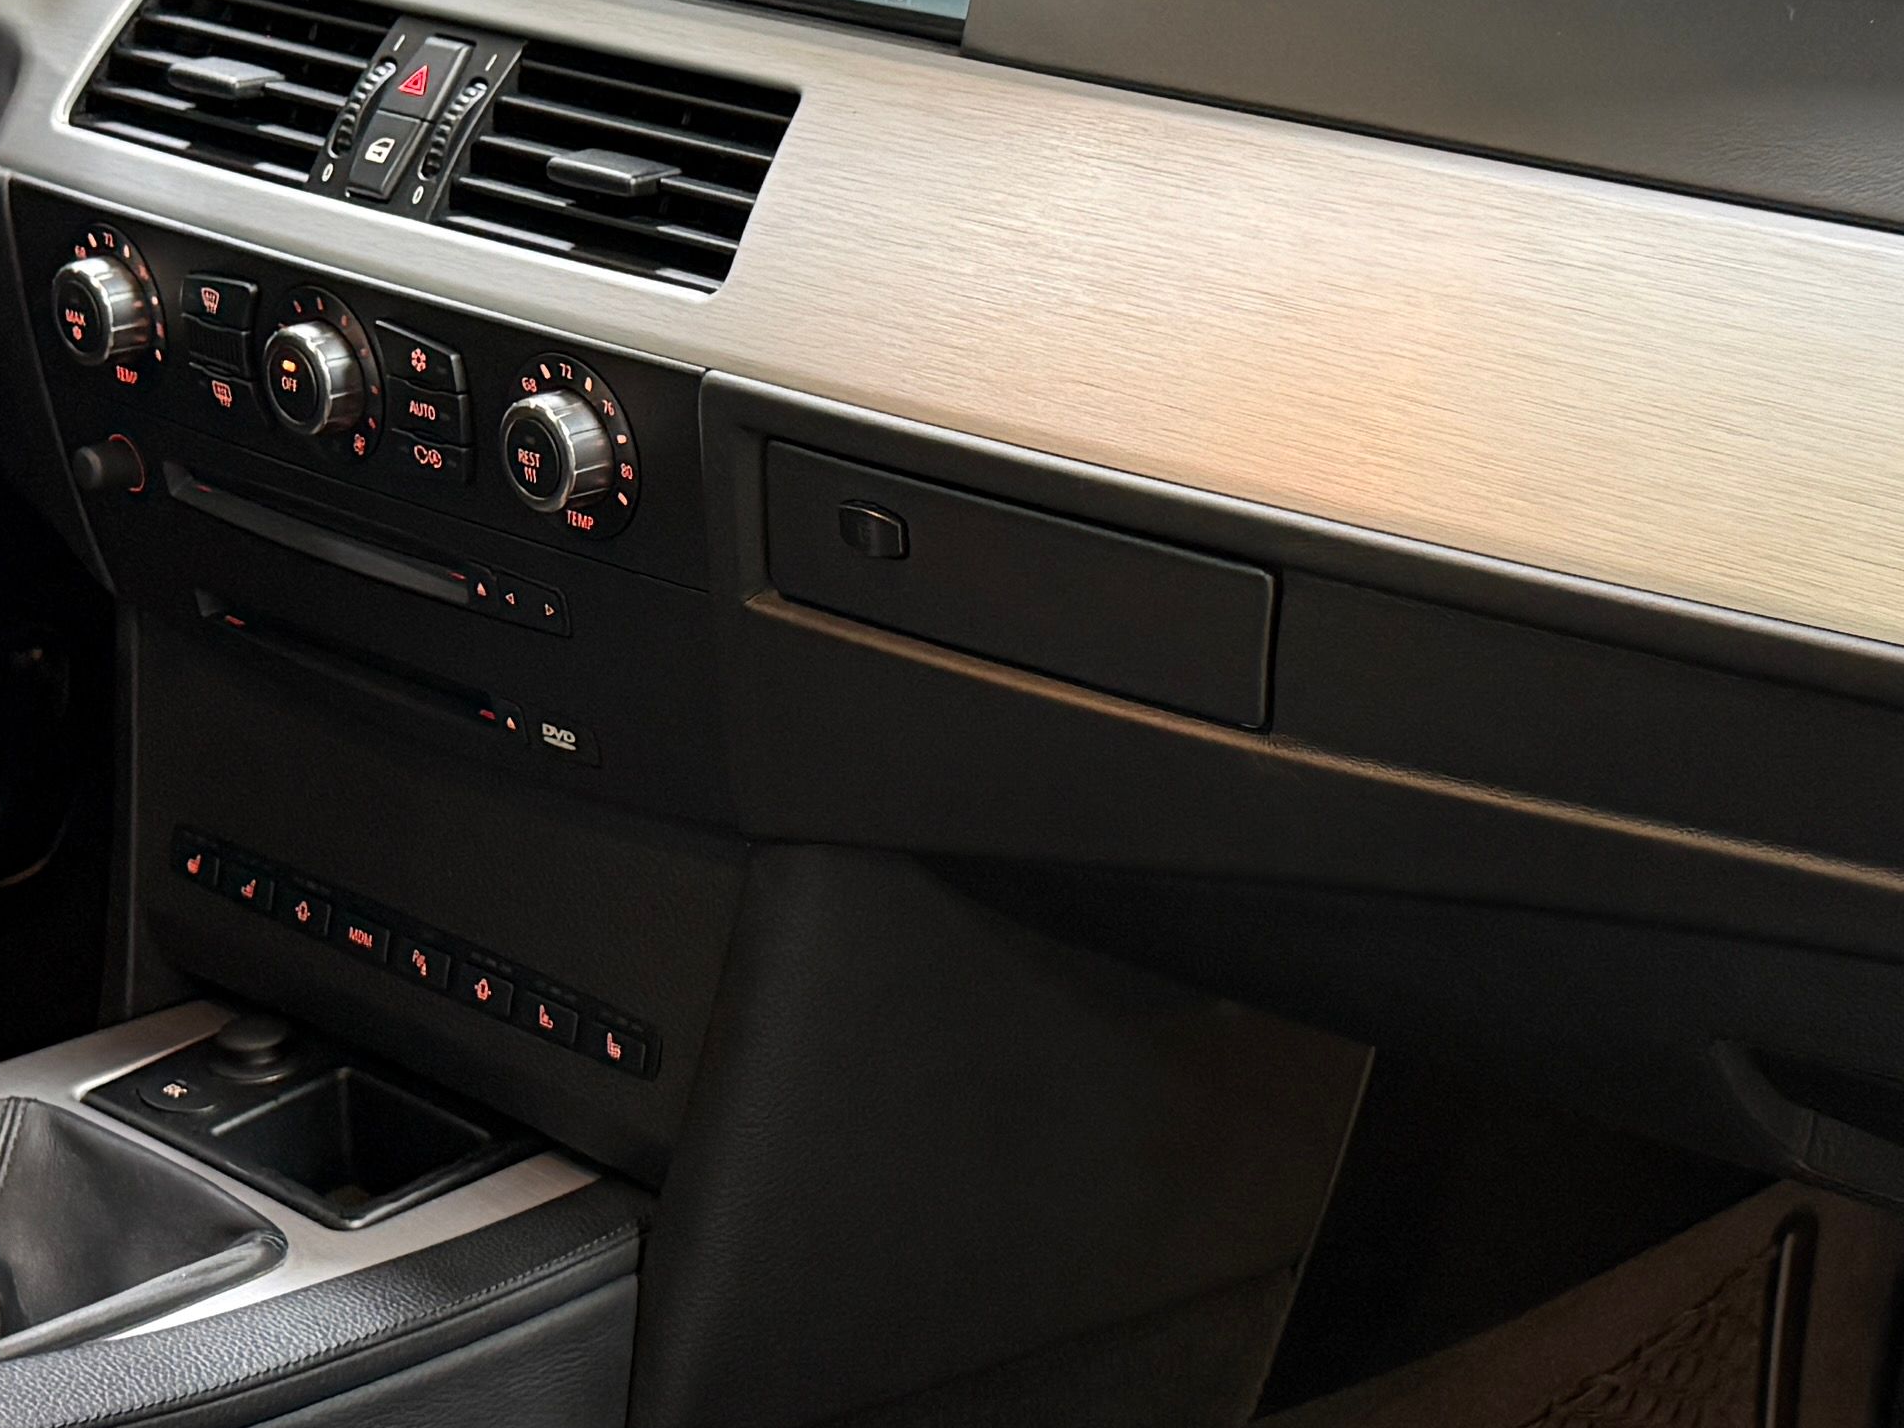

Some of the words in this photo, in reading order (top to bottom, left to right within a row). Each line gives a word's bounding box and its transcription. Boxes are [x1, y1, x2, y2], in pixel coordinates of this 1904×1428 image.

[65, 308, 87, 327] MAX
[115, 365, 138, 384] TEMP
[559, 362, 574, 380] 72
[281, 376, 298, 393] OFF
[521, 376, 538, 393] 68
[409, 399, 436, 421] AUTO
[601, 399, 616, 417] 76
[517, 448, 541, 468] REST
[620, 462, 634, 480] 80
[566, 509, 594, 530] TEMP
[542, 723, 576, 743] DVD
[348, 925, 373, 949] MDM
